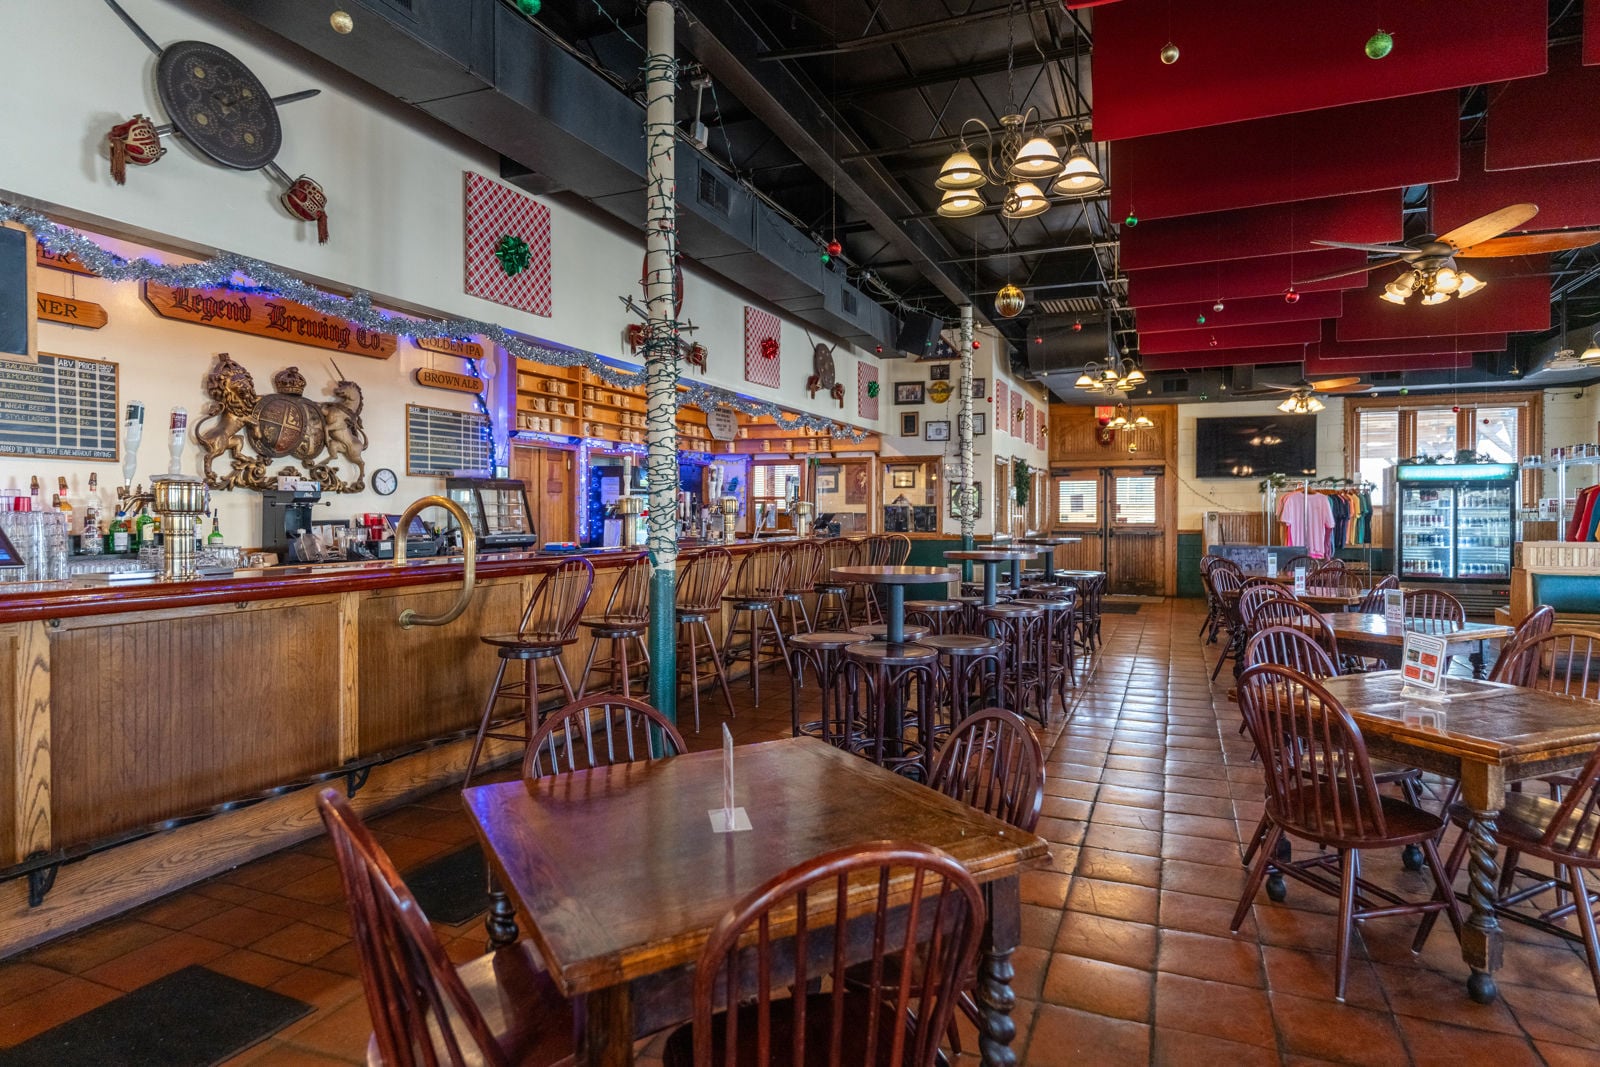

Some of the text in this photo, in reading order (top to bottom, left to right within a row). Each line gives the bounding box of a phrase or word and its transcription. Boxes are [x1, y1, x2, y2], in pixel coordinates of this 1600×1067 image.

[37, 298, 78, 319] NER
[172, 287, 386, 352] Legend Brewing Co.
[421, 338, 481, 357] GOLDEN IPA
[58, 359, 74, 367] ABV
[78, 361, 96, 371] PRICE
[424, 371, 479, 390] BROWN ALE
[5, 401, 25, 410] WHEAT
[28, 404, 47, 412] BEER
[5, 413, 26, 421] STYLE
[24, 447, 34, 455] ALL
